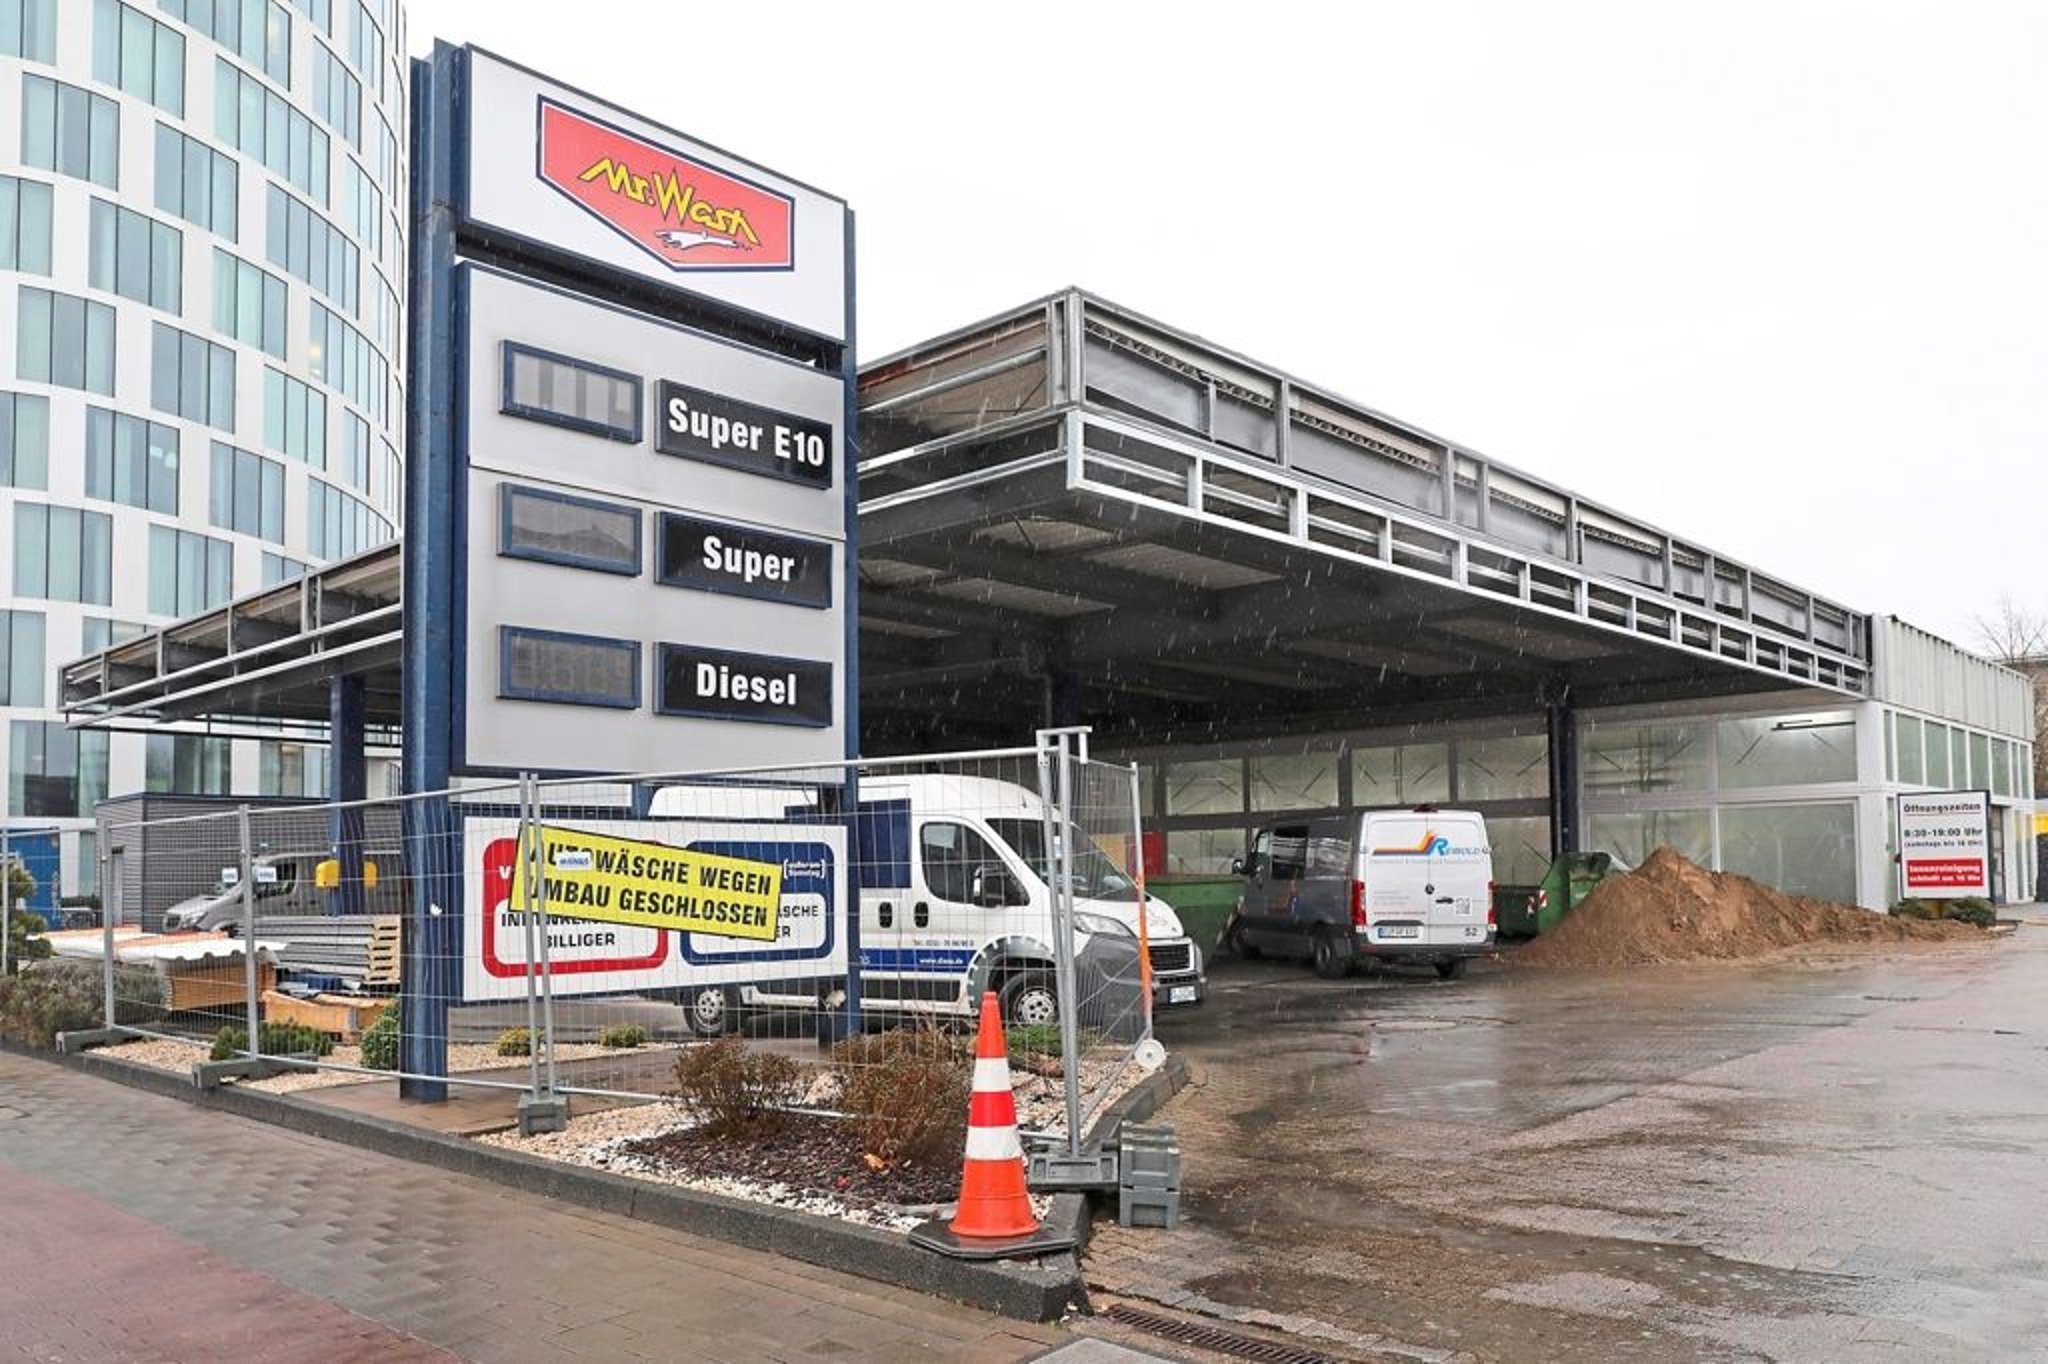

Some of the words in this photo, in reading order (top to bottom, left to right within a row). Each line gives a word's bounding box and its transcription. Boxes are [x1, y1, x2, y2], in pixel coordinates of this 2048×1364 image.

[668, 397, 763, 449] Super
[775, 424, 824, 467] E10
[703, 535, 795, 582] Super
[697, 663, 797, 705] Diesel
[700, 866, 772, 896] WEGEN
[619, 888, 768, 926] GESCHLOSSEN
